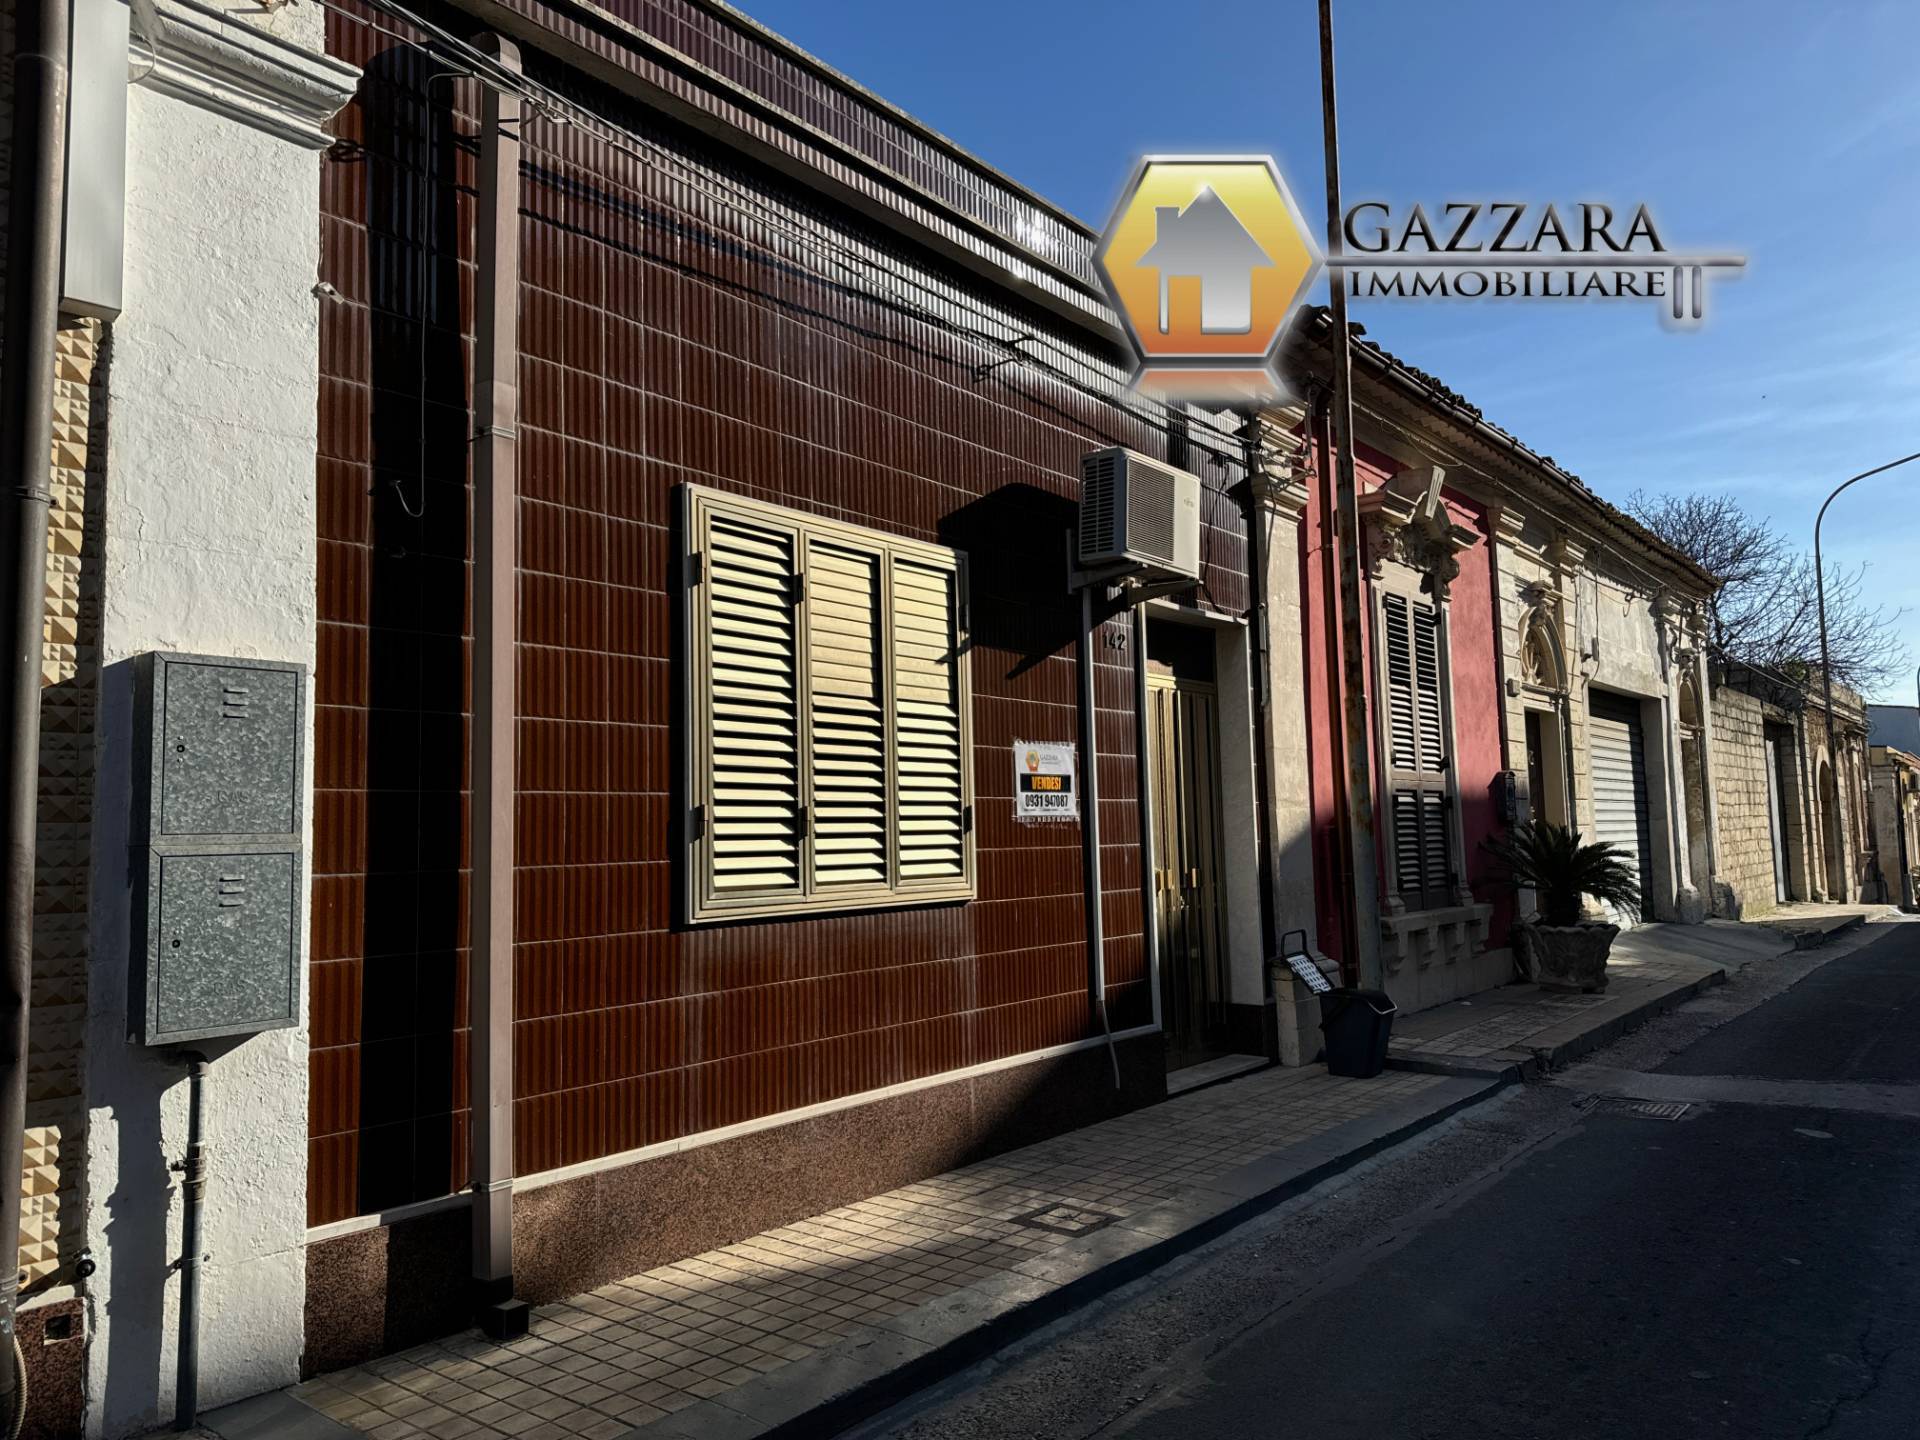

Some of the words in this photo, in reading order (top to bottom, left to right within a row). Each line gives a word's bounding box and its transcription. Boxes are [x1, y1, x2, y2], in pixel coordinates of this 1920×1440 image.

[1102, 631, 1125, 650] 142
[1032, 776, 1061, 790] VENDESI
[1025, 794, 1043, 807] 0931
